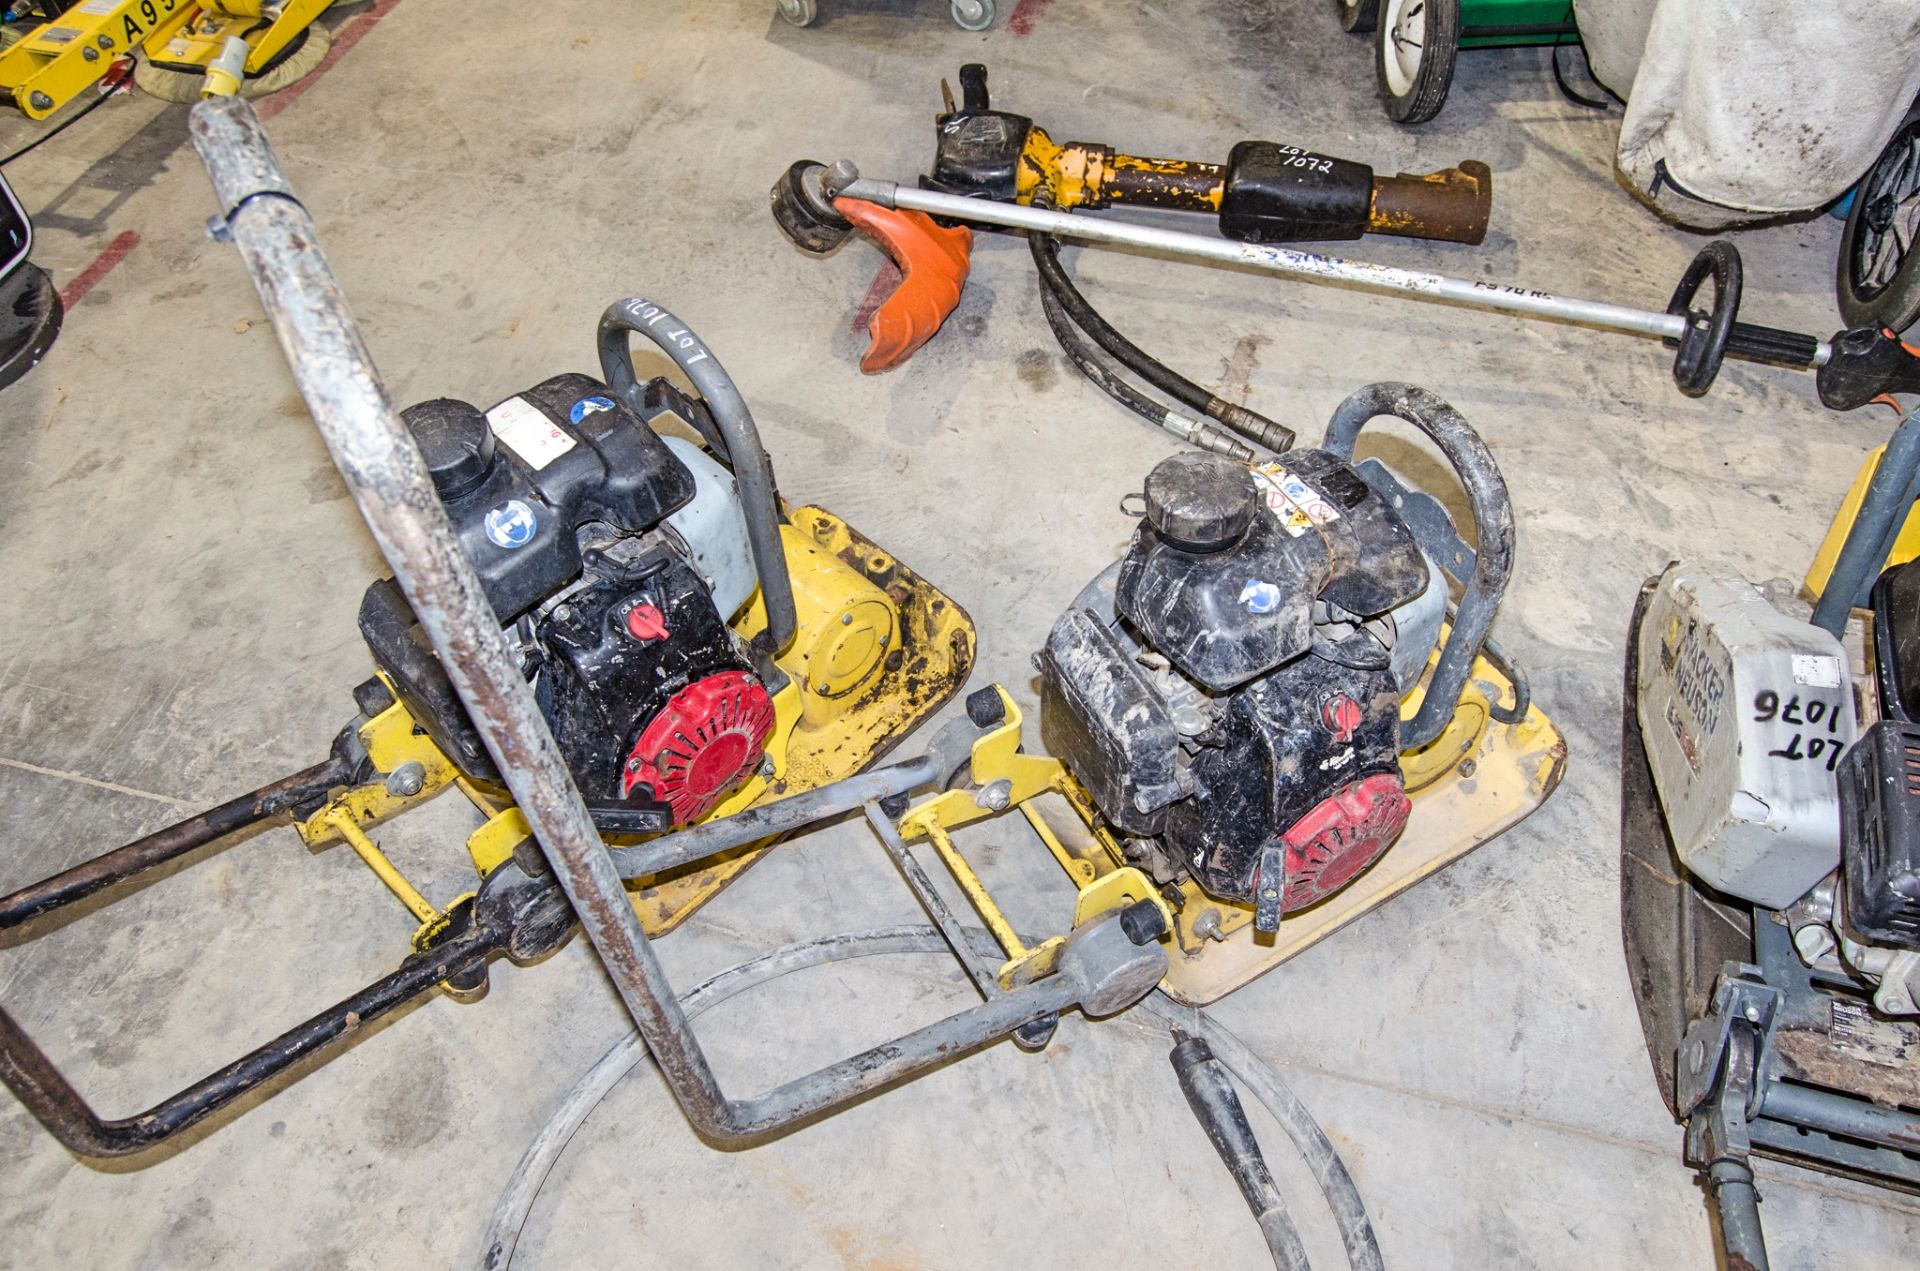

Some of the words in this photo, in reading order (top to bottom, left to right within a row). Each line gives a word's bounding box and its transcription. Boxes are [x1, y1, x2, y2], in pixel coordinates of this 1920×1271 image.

[1283, 156, 1334, 174] 1072
[667, 329, 708, 365] LOT
[1674, 656, 1718, 735] NEUSON
[1753, 689, 1841, 733] 1076
[1768, 733, 1845, 772] LOT
